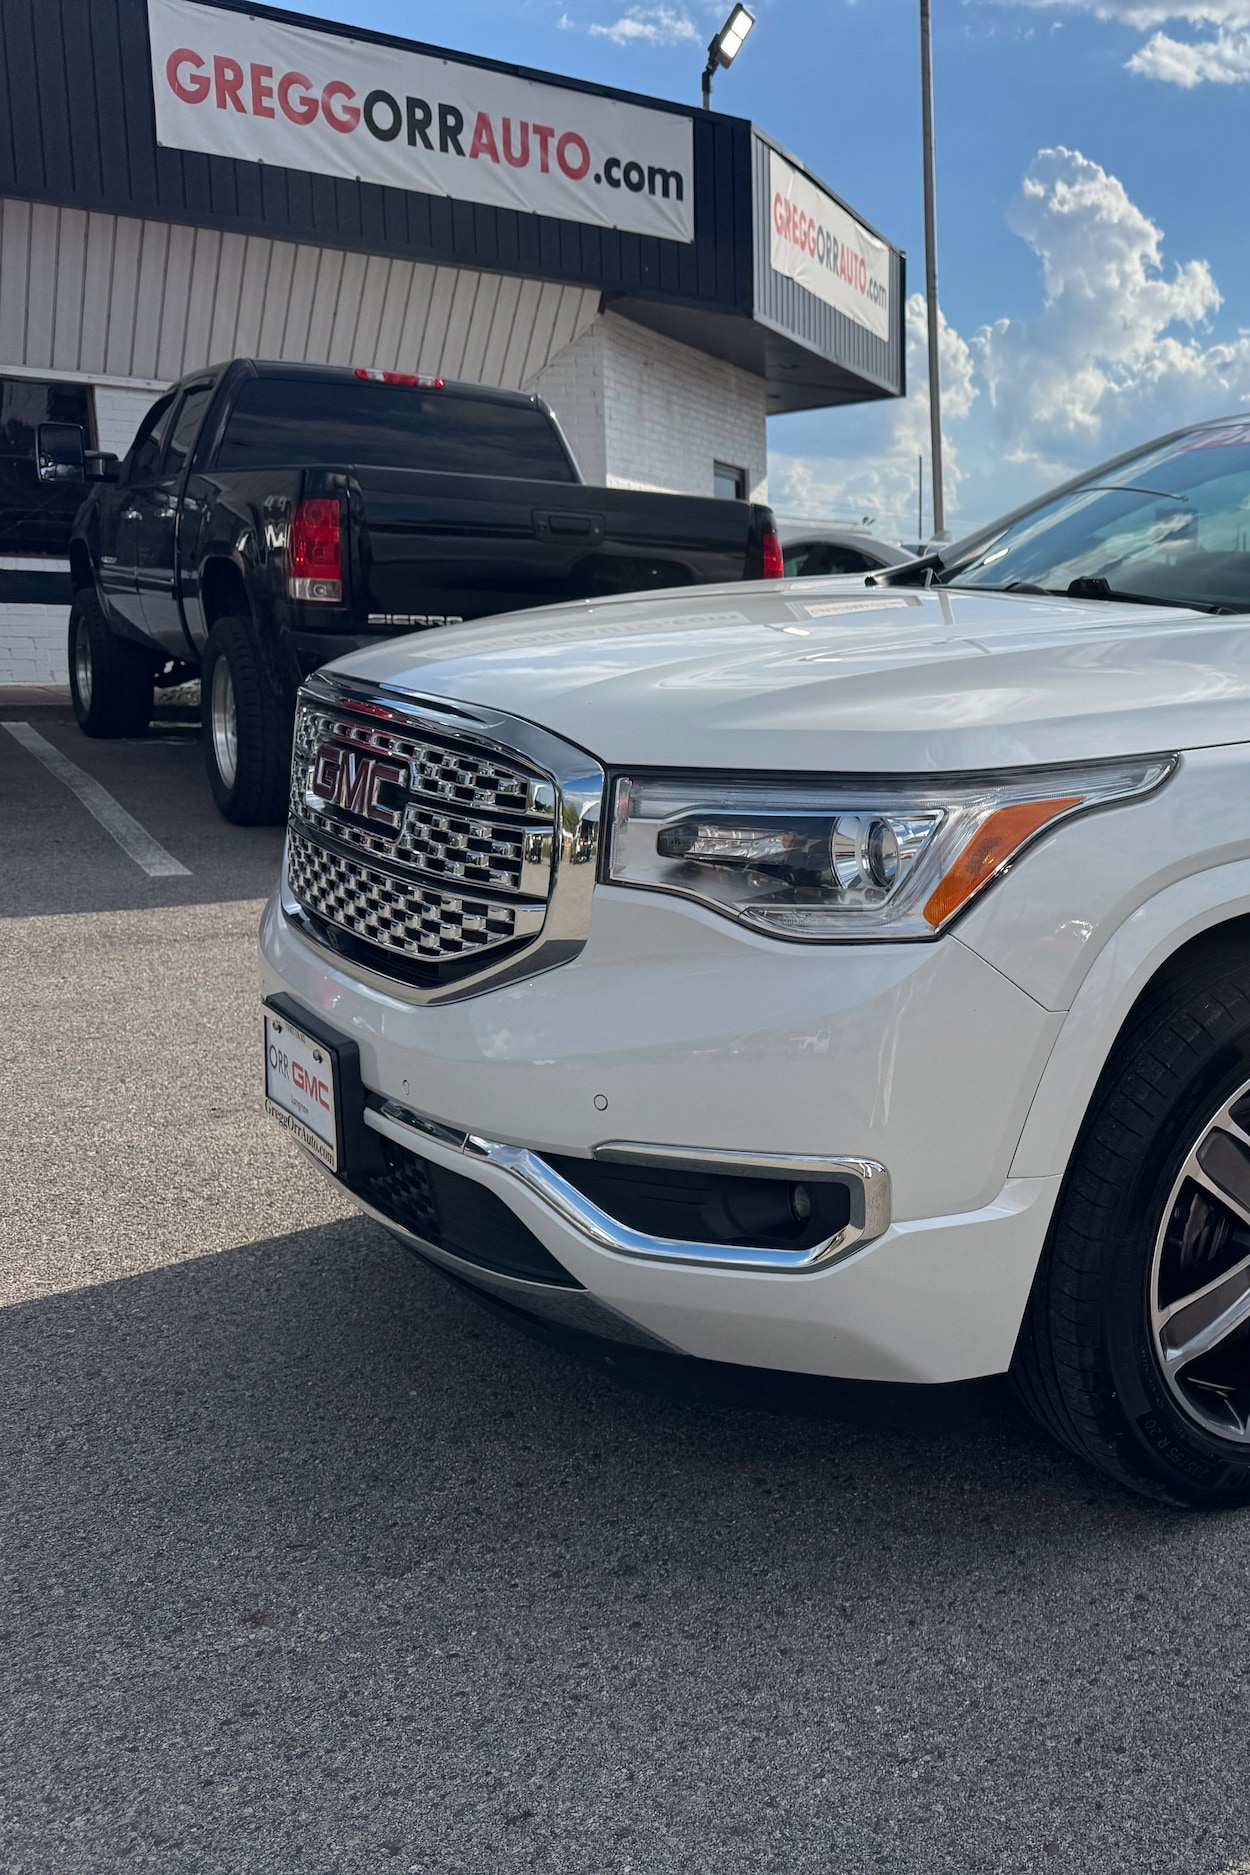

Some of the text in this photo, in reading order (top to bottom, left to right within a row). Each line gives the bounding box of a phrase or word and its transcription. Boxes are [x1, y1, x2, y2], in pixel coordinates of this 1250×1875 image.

[165, 47, 685, 202] GREGGORRAUTO.com
[773, 192, 887, 310] GREGGORRAUTO.com
[312, 744, 407, 829] GMC
[268, 1044, 331, 1111] ORR GMC
[264, 1098, 335, 1167] GreggOrrAuto.com
